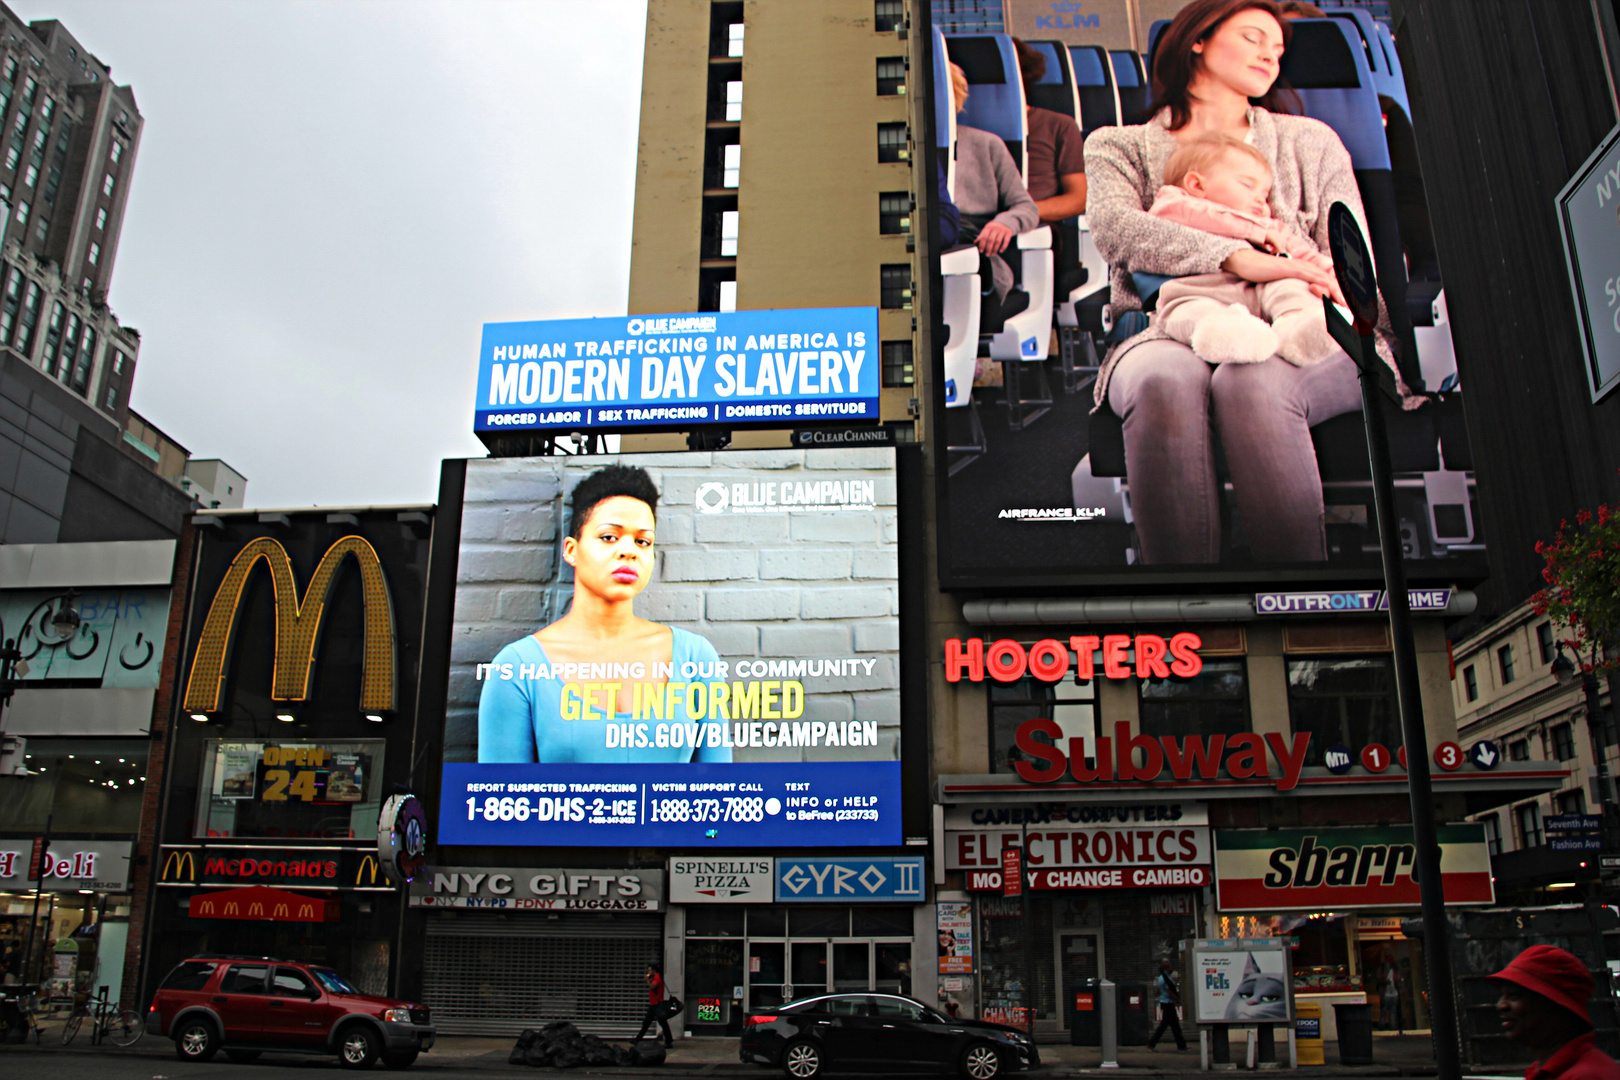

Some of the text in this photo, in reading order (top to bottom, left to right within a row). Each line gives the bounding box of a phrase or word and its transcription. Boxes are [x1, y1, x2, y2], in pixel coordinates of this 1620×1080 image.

[1036, 14, 1100, 29] KLM
[645, 316, 717, 331] BLUE CAMPAIGN
[493, 331, 867, 361] HUMAN TRAFFICKING IN AMERICA IS
[488, 349, 866, 406] MODERN DAY SLAVERY
[487, 411, 582, 426] FORCED LABOR
[598, 406, 708, 422] SEX TRAFFICKING
[725, 402, 867, 418] DOMESTIC SERVITUDE
[732, 480, 875, 507] BLUE CAMPAIGN
[998, 507, 1106, 518] AIRFRANCE KLM
[80, 592, 146, 621] BAR
[1260, 591, 1445, 611] OUTFRONT IME
[944, 631, 1203, 683] HOOTERS
[475, 658, 877, 681] IT'S HAPPENING IN OUR COMMUNITY
[559, 680, 805, 721] GET INFORMED
[605, 720, 878, 749] DHS.GOV/BLUECAMPAIGN
[262, 746, 325, 767] OPEN
[1013, 717, 1312, 791] Subway
[1325, 750, 1350, 769] MTA
[1368, 748, 1381, 768] 1
[1441, 745, 1457, 766] 3
[262, 769, 319, 802] 24
[467, 783, 638, 793] REPORT SUSPECTED TRAFFICKING
[651, 783, 764, 792] VICTIM SUPPORT CALL
[785, 782, 810, 791] TEXT
[786, 796, 879, 808] INFO or HELP
[786, 809, 879, 822] to BeFree (233733)
[1066, 803, 1183, 823] COMPUTERS
[1547, 819, 1599, 829] Seventh Ave
[1551, 840, 1601, 850] Fashion Ave
[203, 858, 338, 878] McDonald's
[675, 861, 769, 874] SPINELLI'S
[1263, 835, 1443, 889] sbarr
[433, 870, 642, 896] NYC GIFTS
[694, 875, 751, 888] PIZZA
[781, 863, 920, 895] GYRO II
[973, 871, 1039, 889] MOY
[1046, 870, 1123, 888] CHANGE
[1132, 868, 1204, 887] CAMBIO
[515, 899, 555, 909] FDNY
[565, 899, 648, 910] LUGGAGE
[980, 897, 1022, 917] CHANGE
[1150, 893, 1190, 914] MONEY
[698, 998, 721, 1006] PIZZA
[698, 1005, 721, 1013] PIZZA
[698, 1012, 721, 1021] PIZZA
